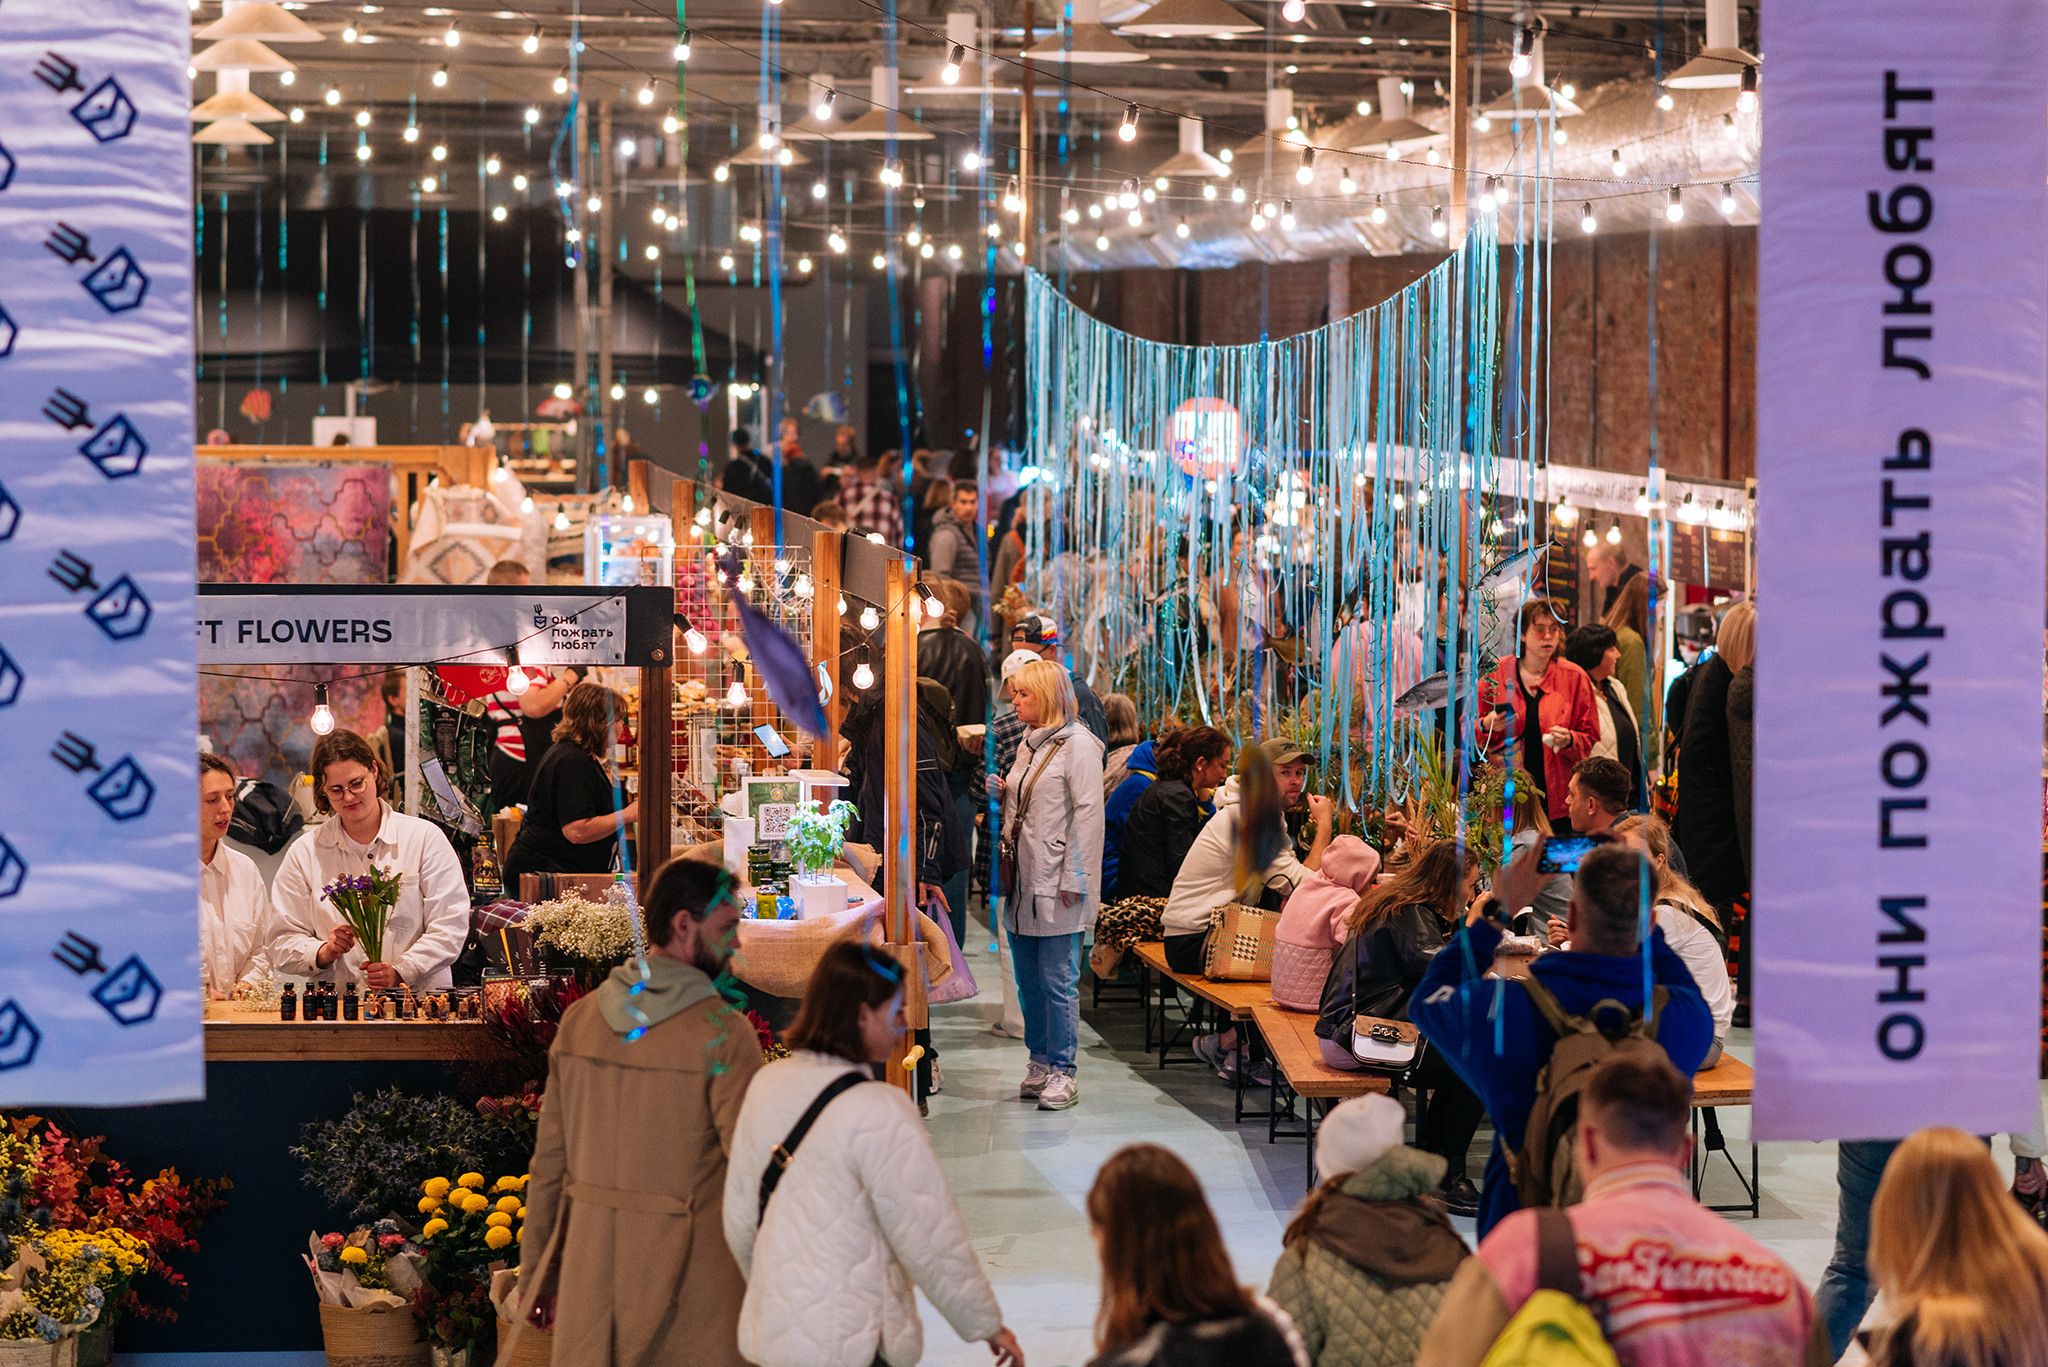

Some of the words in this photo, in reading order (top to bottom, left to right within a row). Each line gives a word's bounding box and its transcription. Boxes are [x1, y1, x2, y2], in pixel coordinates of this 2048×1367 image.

[1867, 70, 1935, 380] любят
[238, 620, 392, 643] FLOWERS
[551, 628, 614, 639] пожрать
[551, 640, 597, 650] любят
[1879, 428, 1945, 849] пожрать
[1876, 896, 1927, 1062] они
